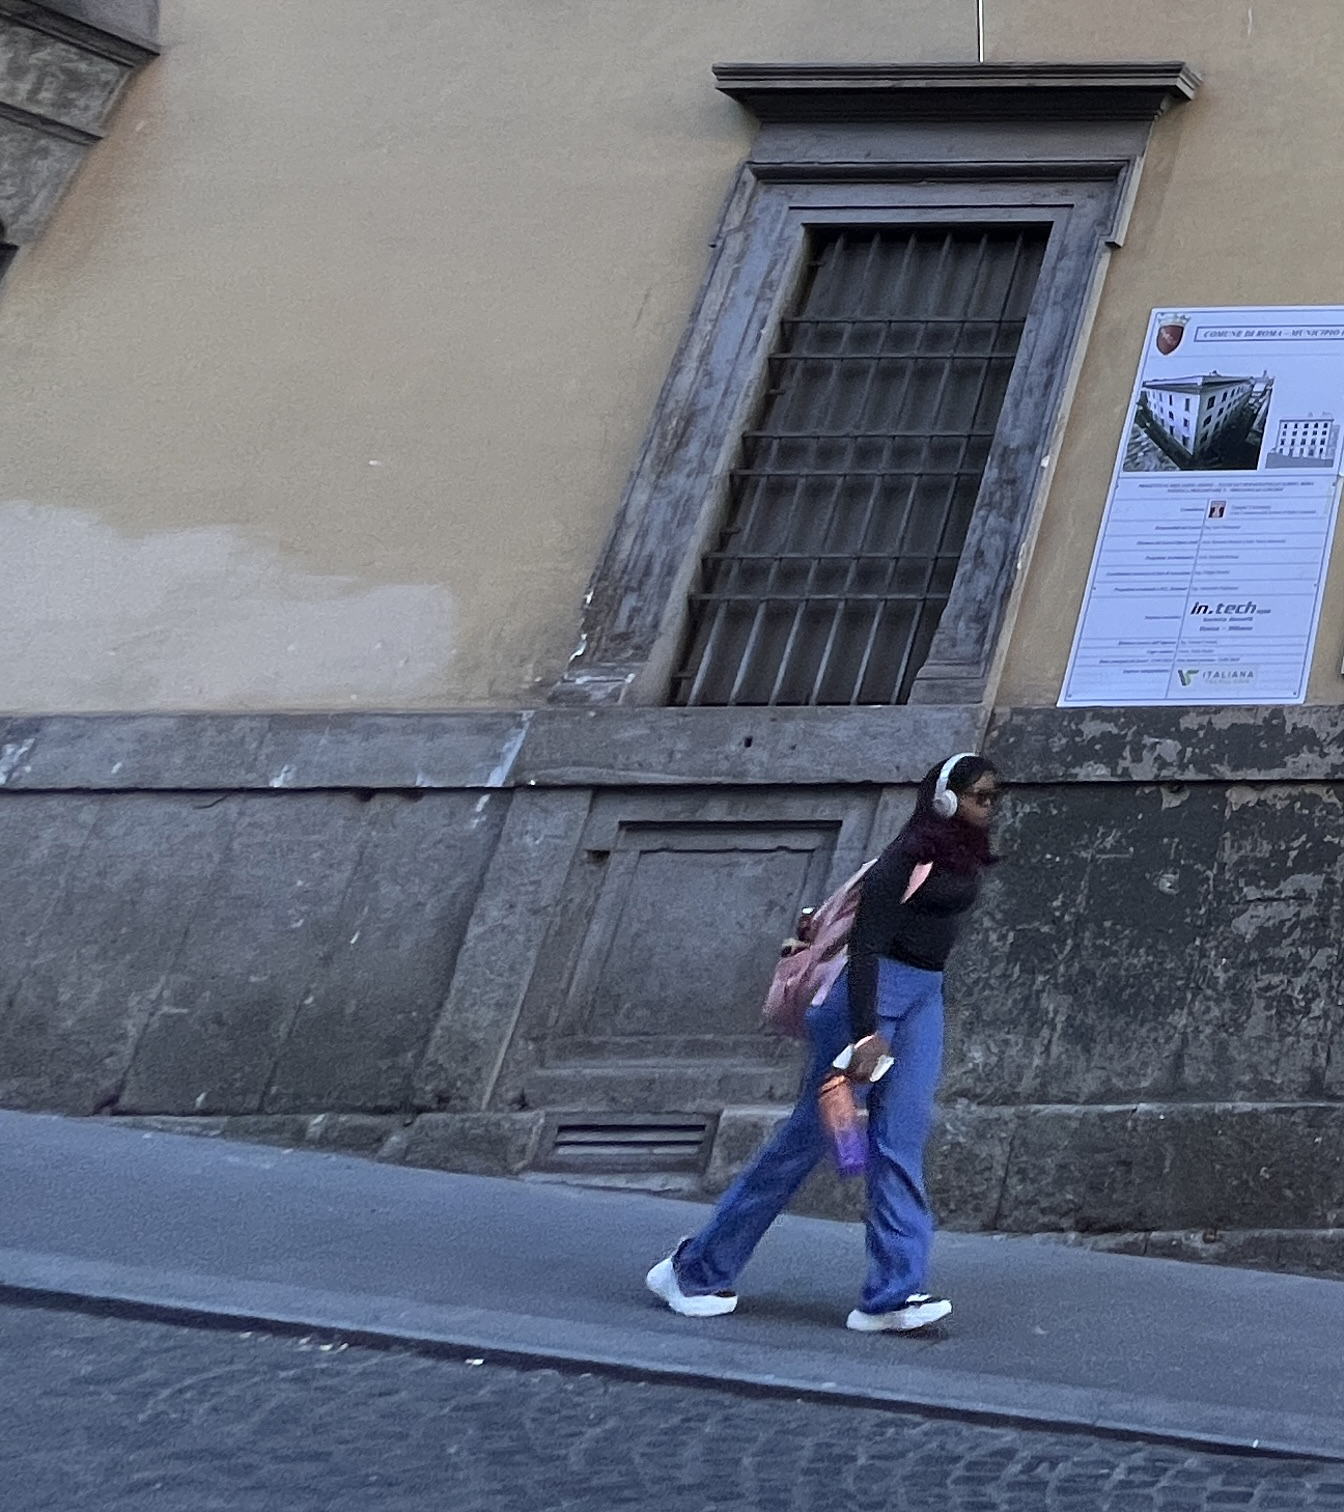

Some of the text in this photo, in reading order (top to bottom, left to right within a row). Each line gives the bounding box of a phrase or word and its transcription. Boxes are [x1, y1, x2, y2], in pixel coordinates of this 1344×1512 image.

[1256, 329, 1283, 337] ROMA
[1190, 601, 1257, 615] in.tech
[1203, 671, 1254, 679] ITALIANA
